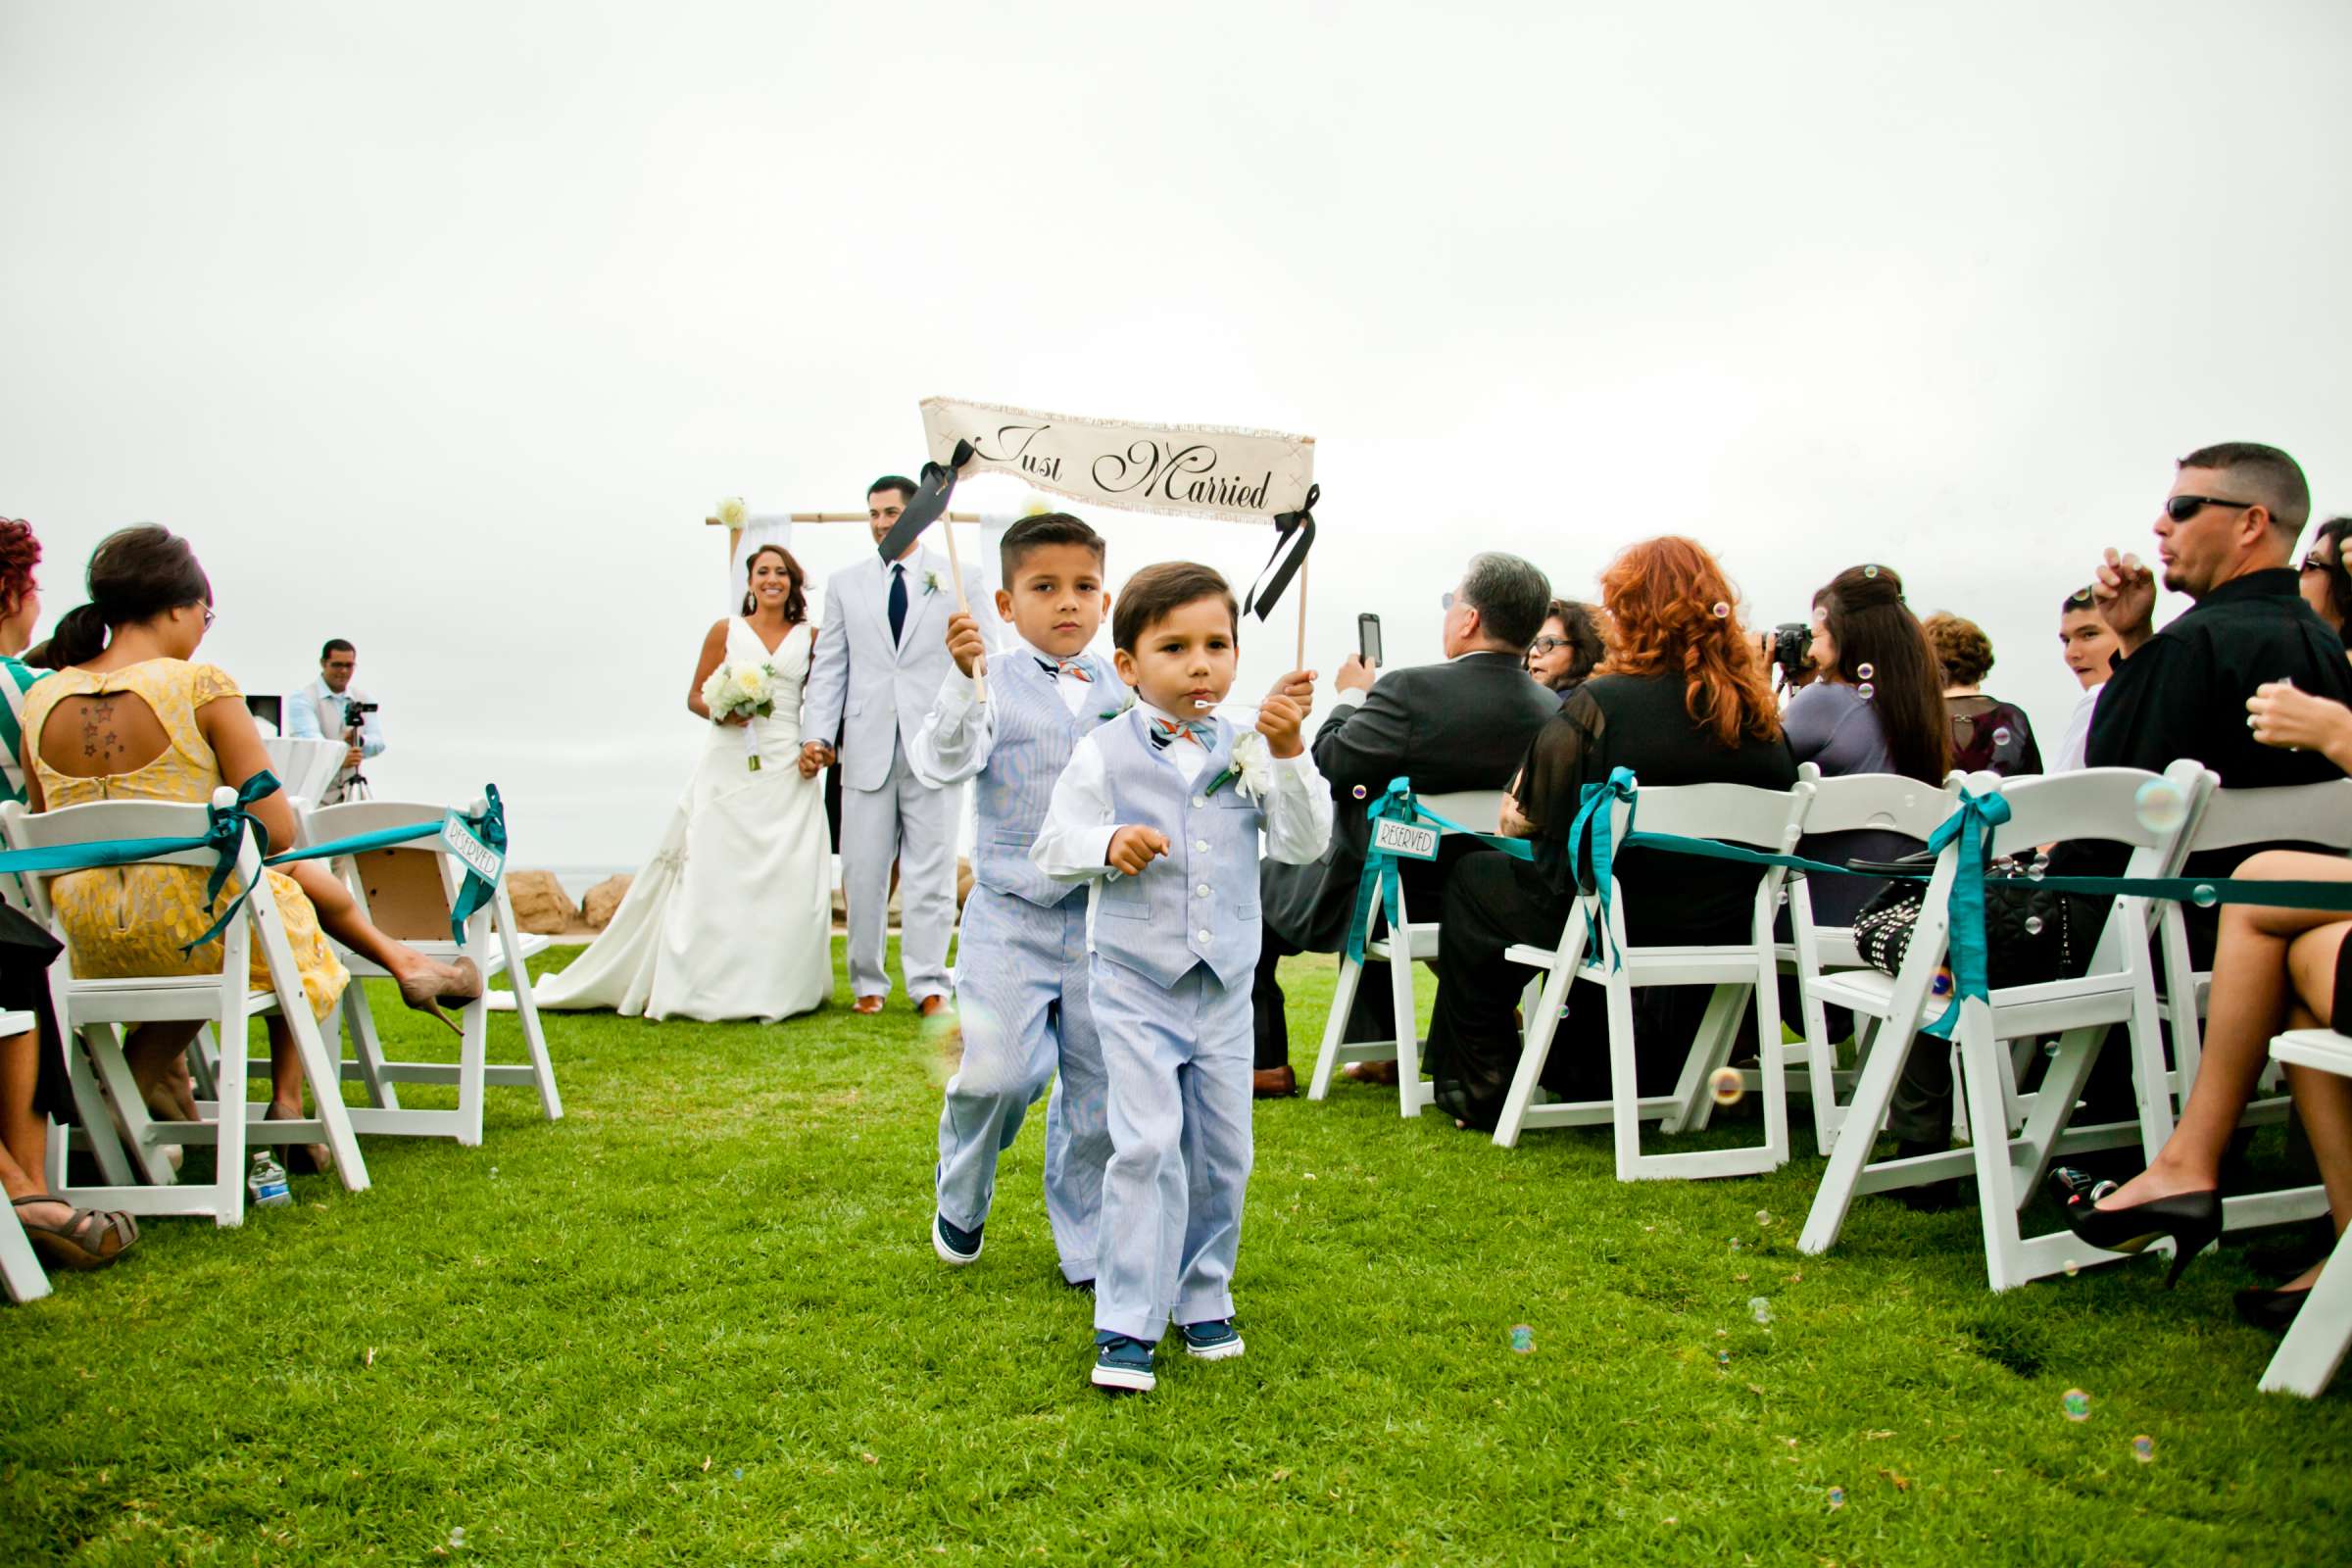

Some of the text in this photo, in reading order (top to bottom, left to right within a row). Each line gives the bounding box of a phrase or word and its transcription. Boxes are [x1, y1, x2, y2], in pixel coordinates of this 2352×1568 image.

[974, 424, 1272, 510] Just Married
[450, 822, 496, 873] RESERVED
[1381, 823, 1432, 852] RESERVED
